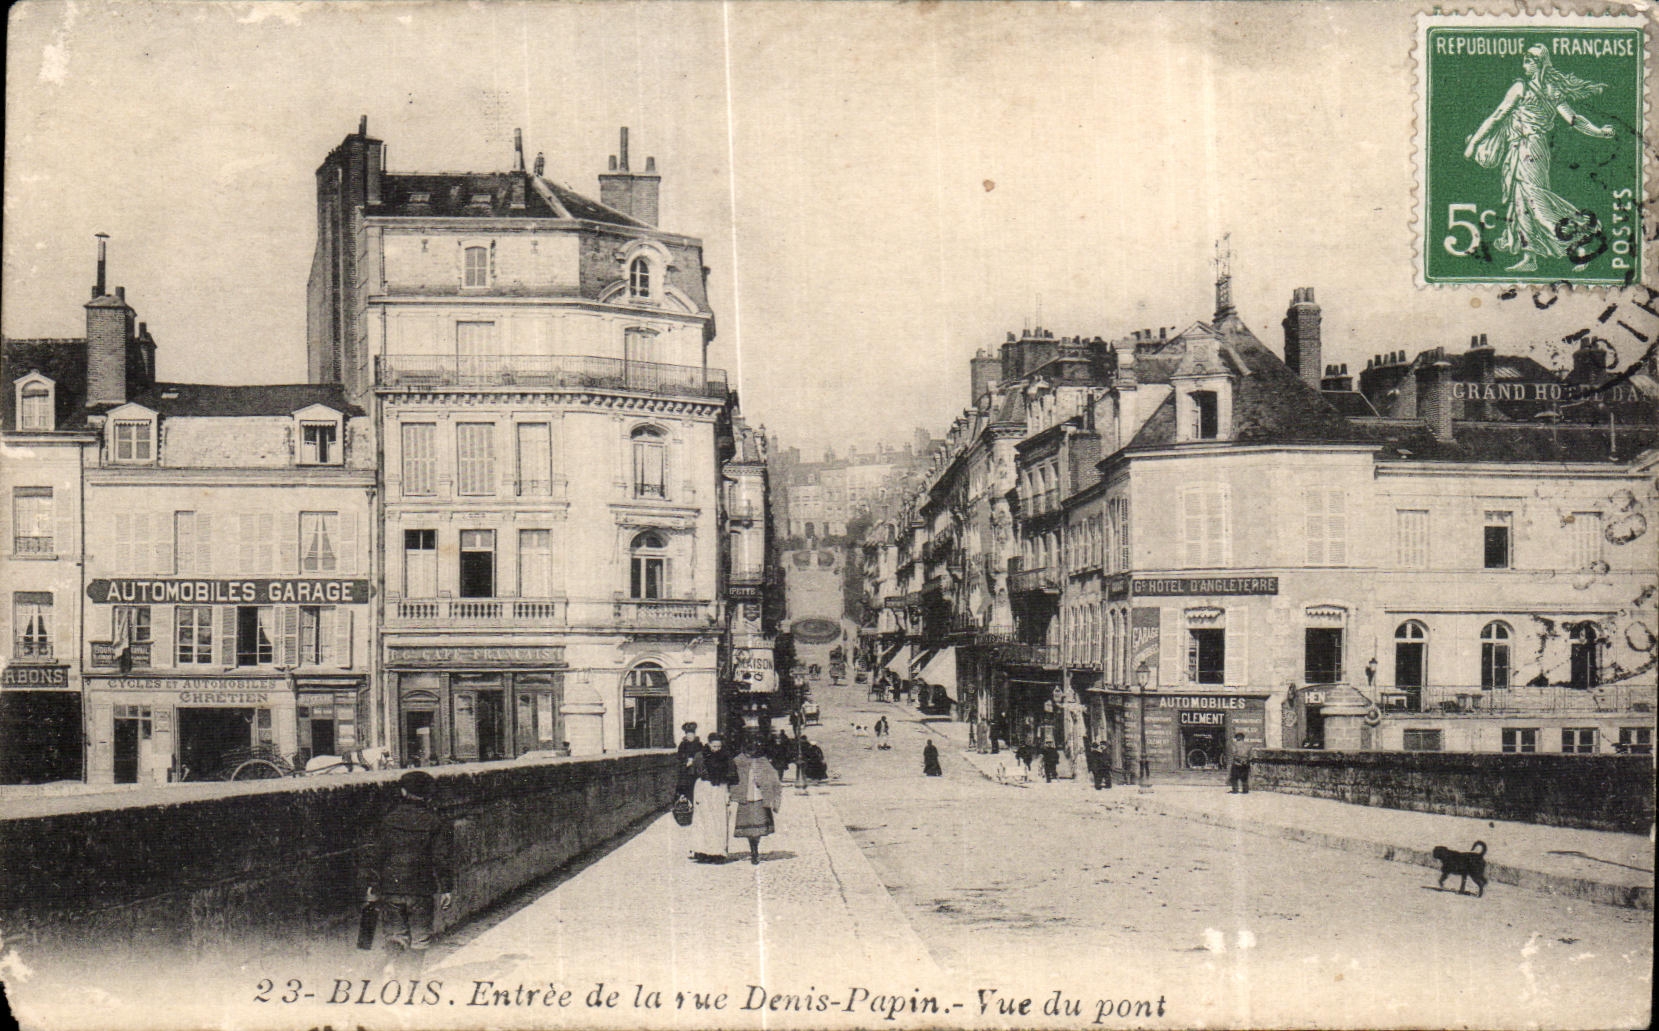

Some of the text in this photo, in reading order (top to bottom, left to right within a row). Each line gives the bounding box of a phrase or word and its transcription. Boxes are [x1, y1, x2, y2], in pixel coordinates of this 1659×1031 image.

[1553, 38, 1634, 57] FRANÇAISE
[1611, 188, 1633, 269] POSTES
[1453, 383, 1525, 400] GRAND
[107, 582, 354, 602] AUTOMOBILES GARAGE
[1150, 580, 1185, 592] HOTEL
[1190, 578, 1276, 593] D'ANGLETERRE
[107, 679, 161, 689] CYCLES
[183, 679, 276, 689] AUTOMOBILES
[1160, 697, 1246, 709] AUTOMOBILES
[1181, 712, 1224, 724] CLEMENT
